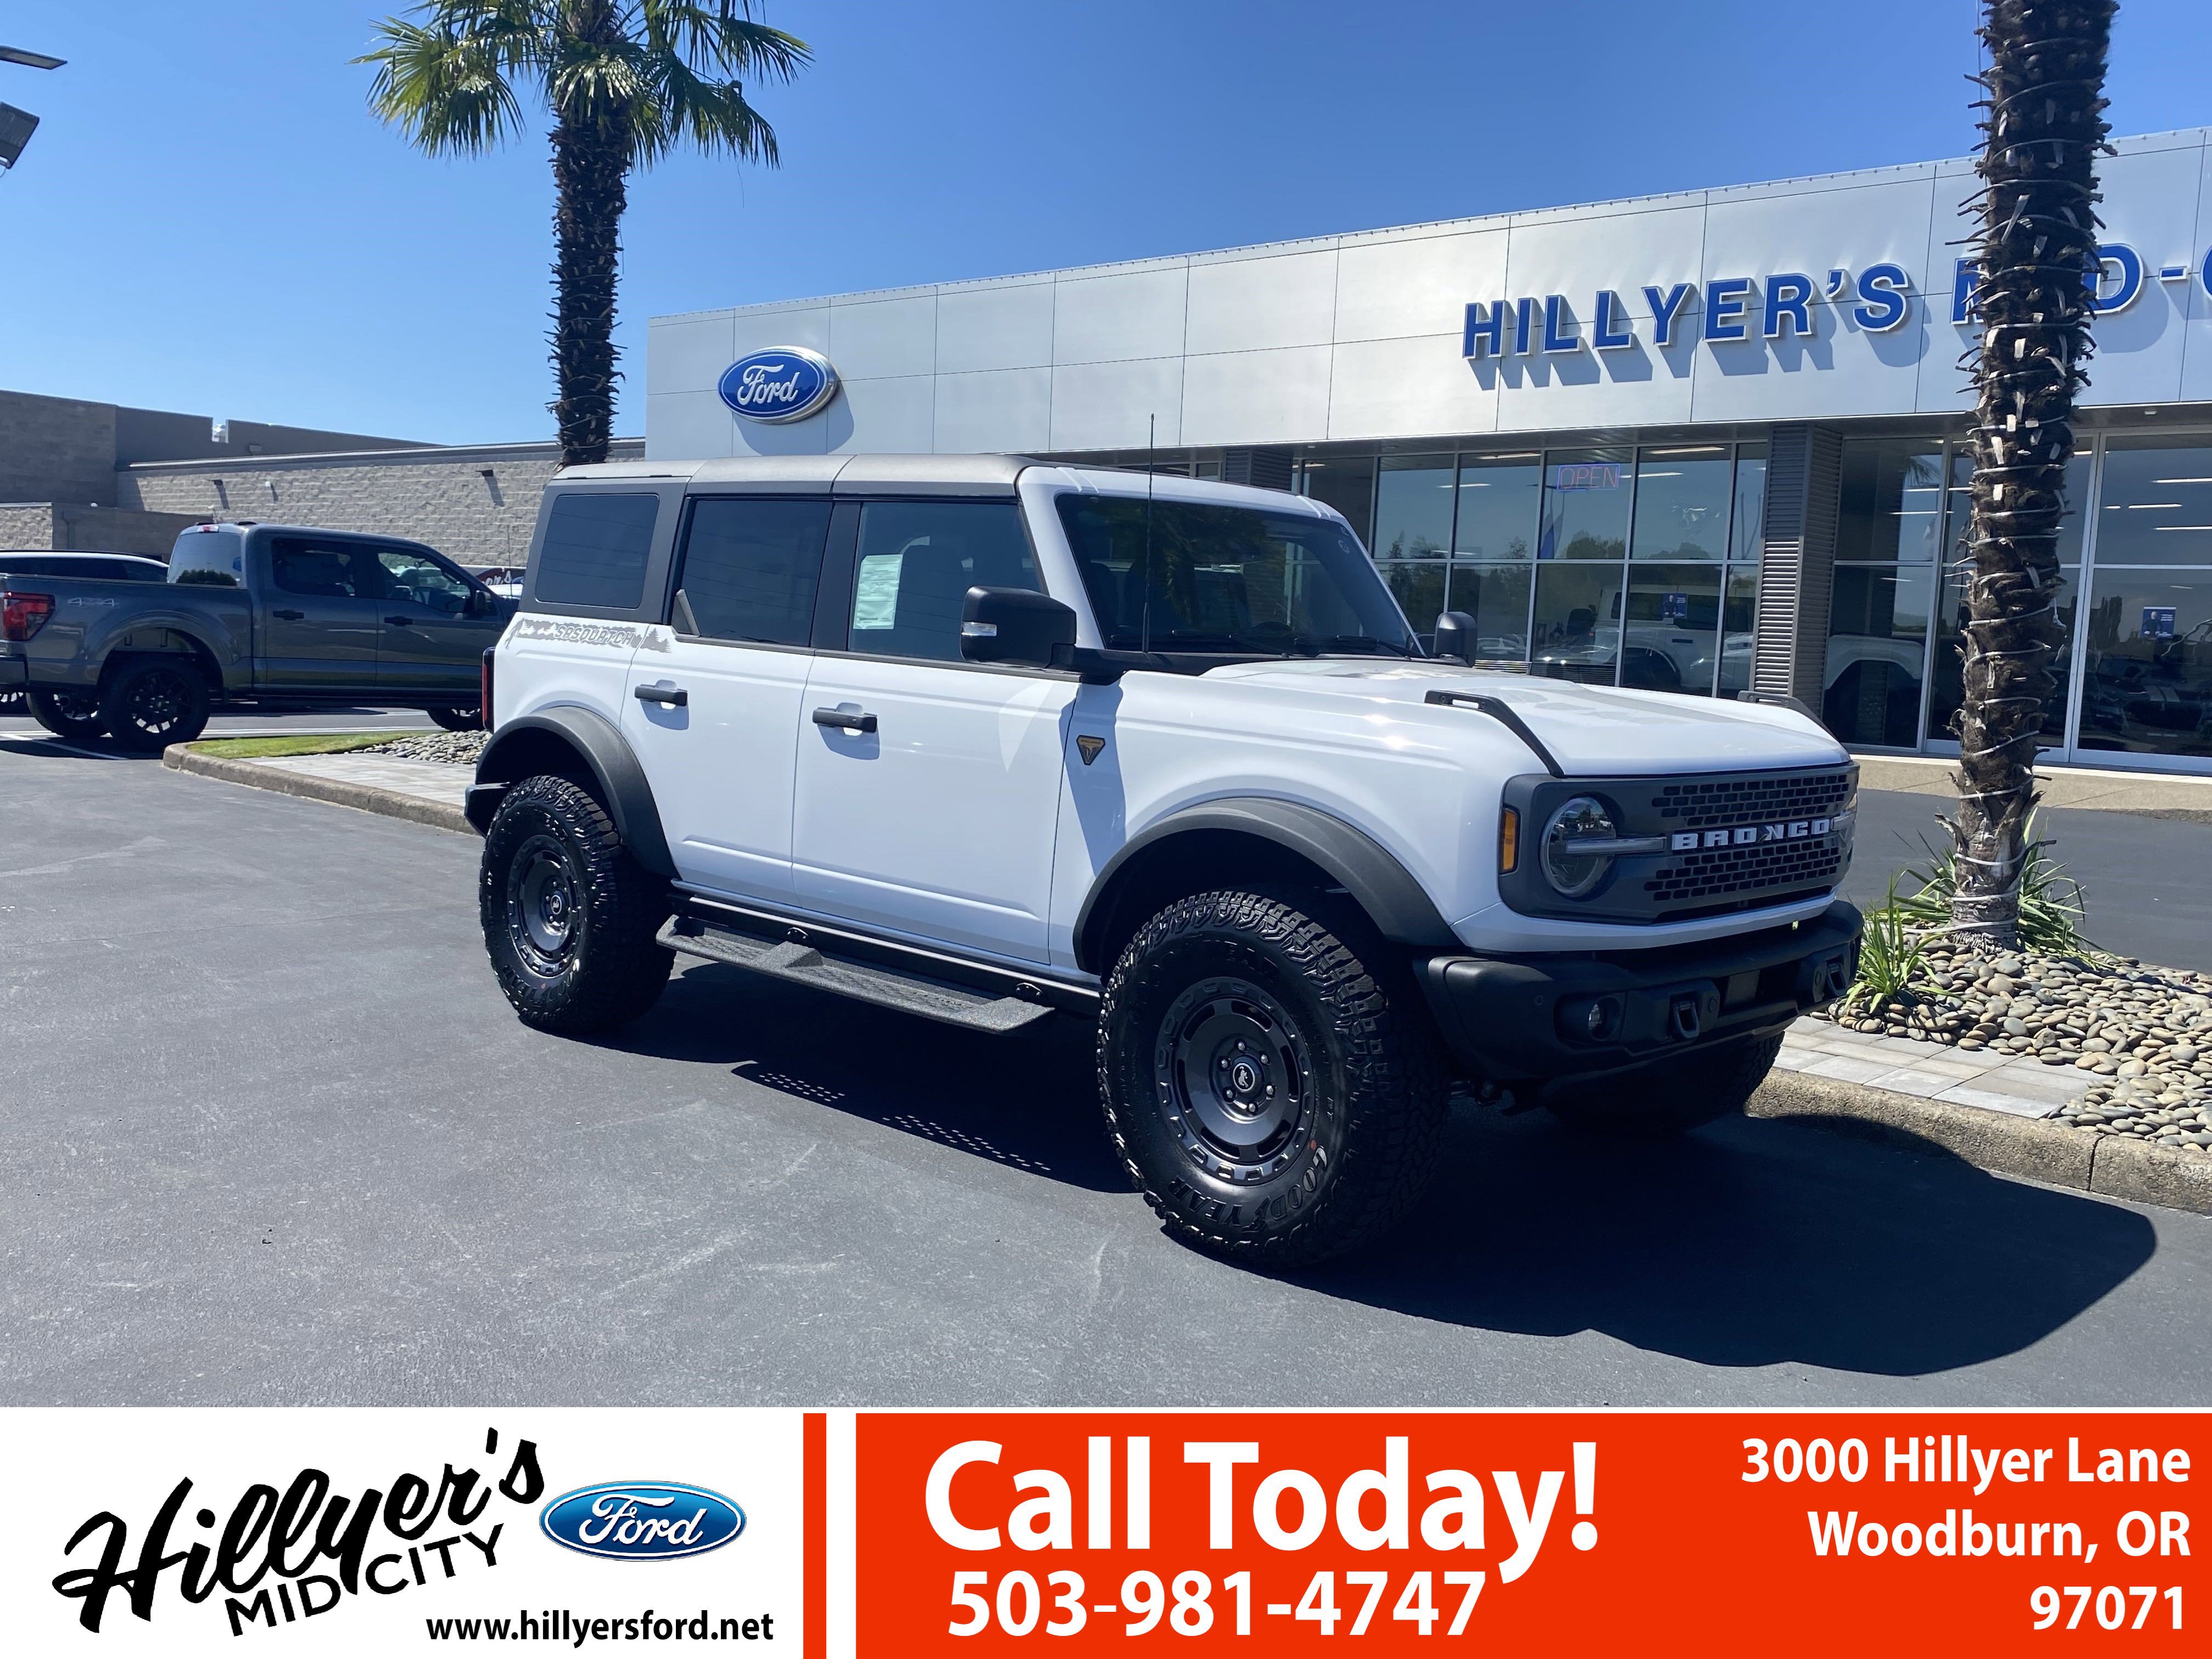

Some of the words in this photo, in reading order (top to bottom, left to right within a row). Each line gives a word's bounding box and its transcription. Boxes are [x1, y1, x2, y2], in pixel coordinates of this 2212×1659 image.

[1462, 263, 1909, 359] HILLYER'S
[737, 364, 800, 406] Ford
[1560, 466, 1619, 489] OPEN
[554, 624, 635, 645] SASQUATCH
[1672, 819, 1830, 850] BRONCO
[1168, 1145, 1328, 1231] GOODYEAR
